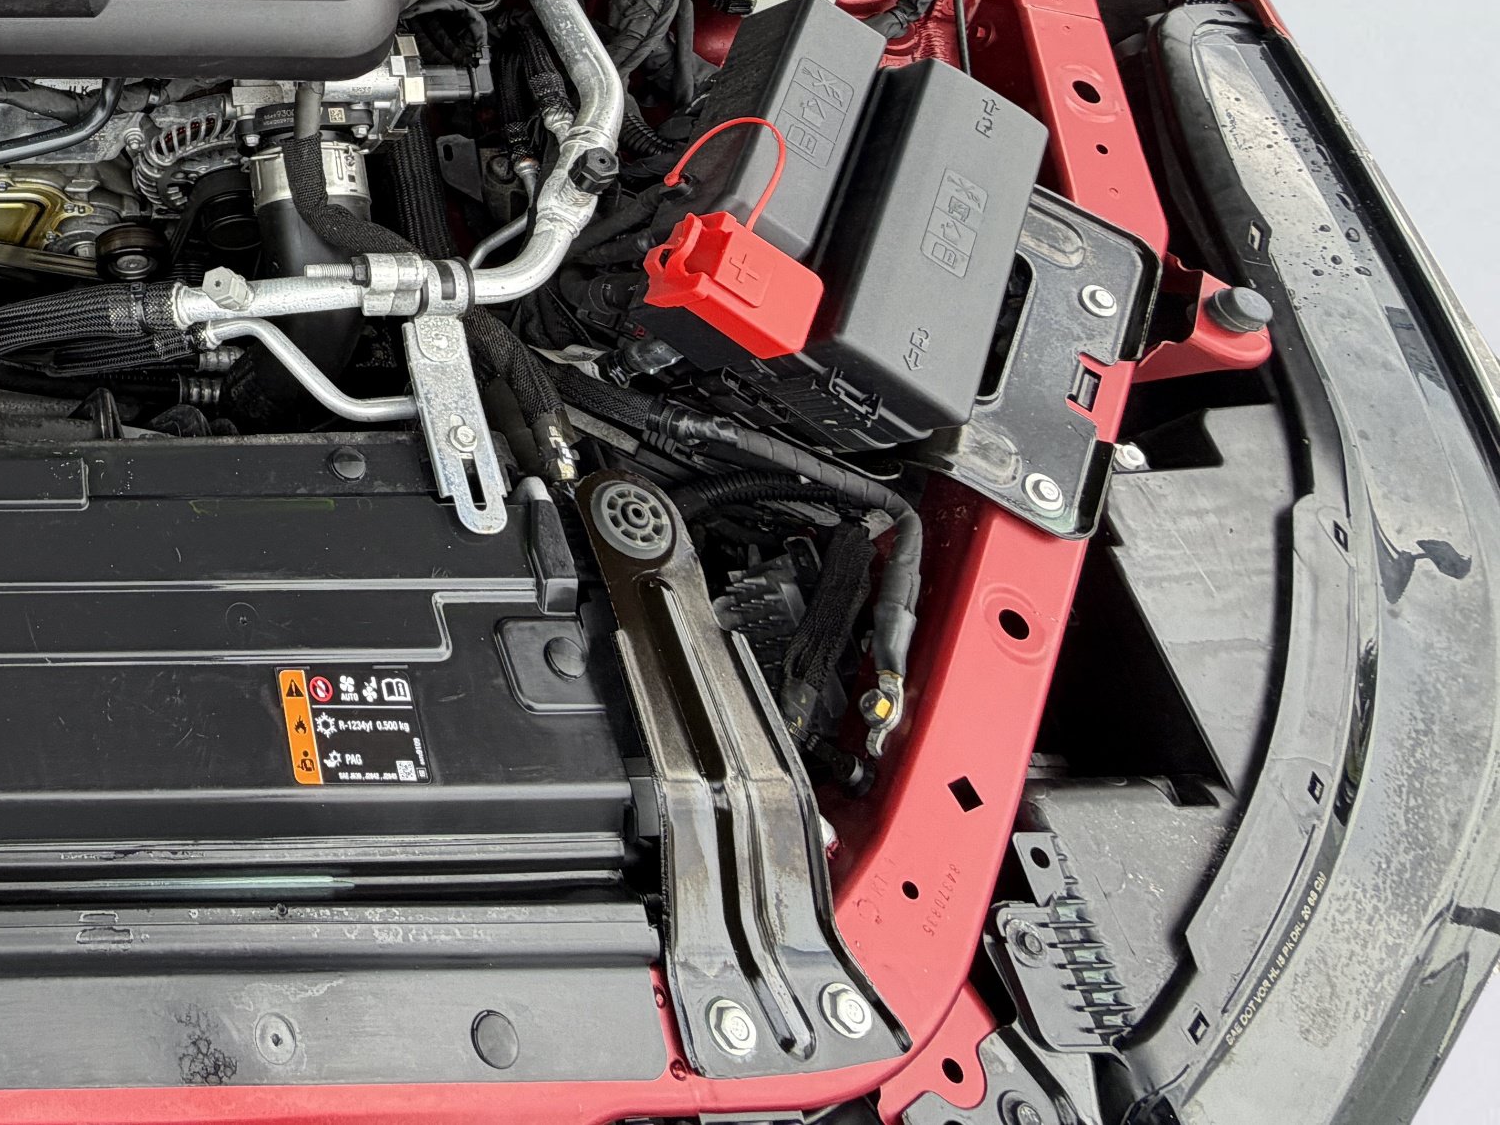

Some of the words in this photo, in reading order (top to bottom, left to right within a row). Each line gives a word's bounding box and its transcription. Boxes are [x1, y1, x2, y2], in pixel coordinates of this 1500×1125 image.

[341, 693, 359, 702] AUTO
[339, 720, 373, 733] R-1234yf
[376, 721, 397, 731] 0.500
[398, 721, 410, 733] kg
[345, 754, 363, 765] PAG
[1240, 1001, 1256, 1024] DOT
